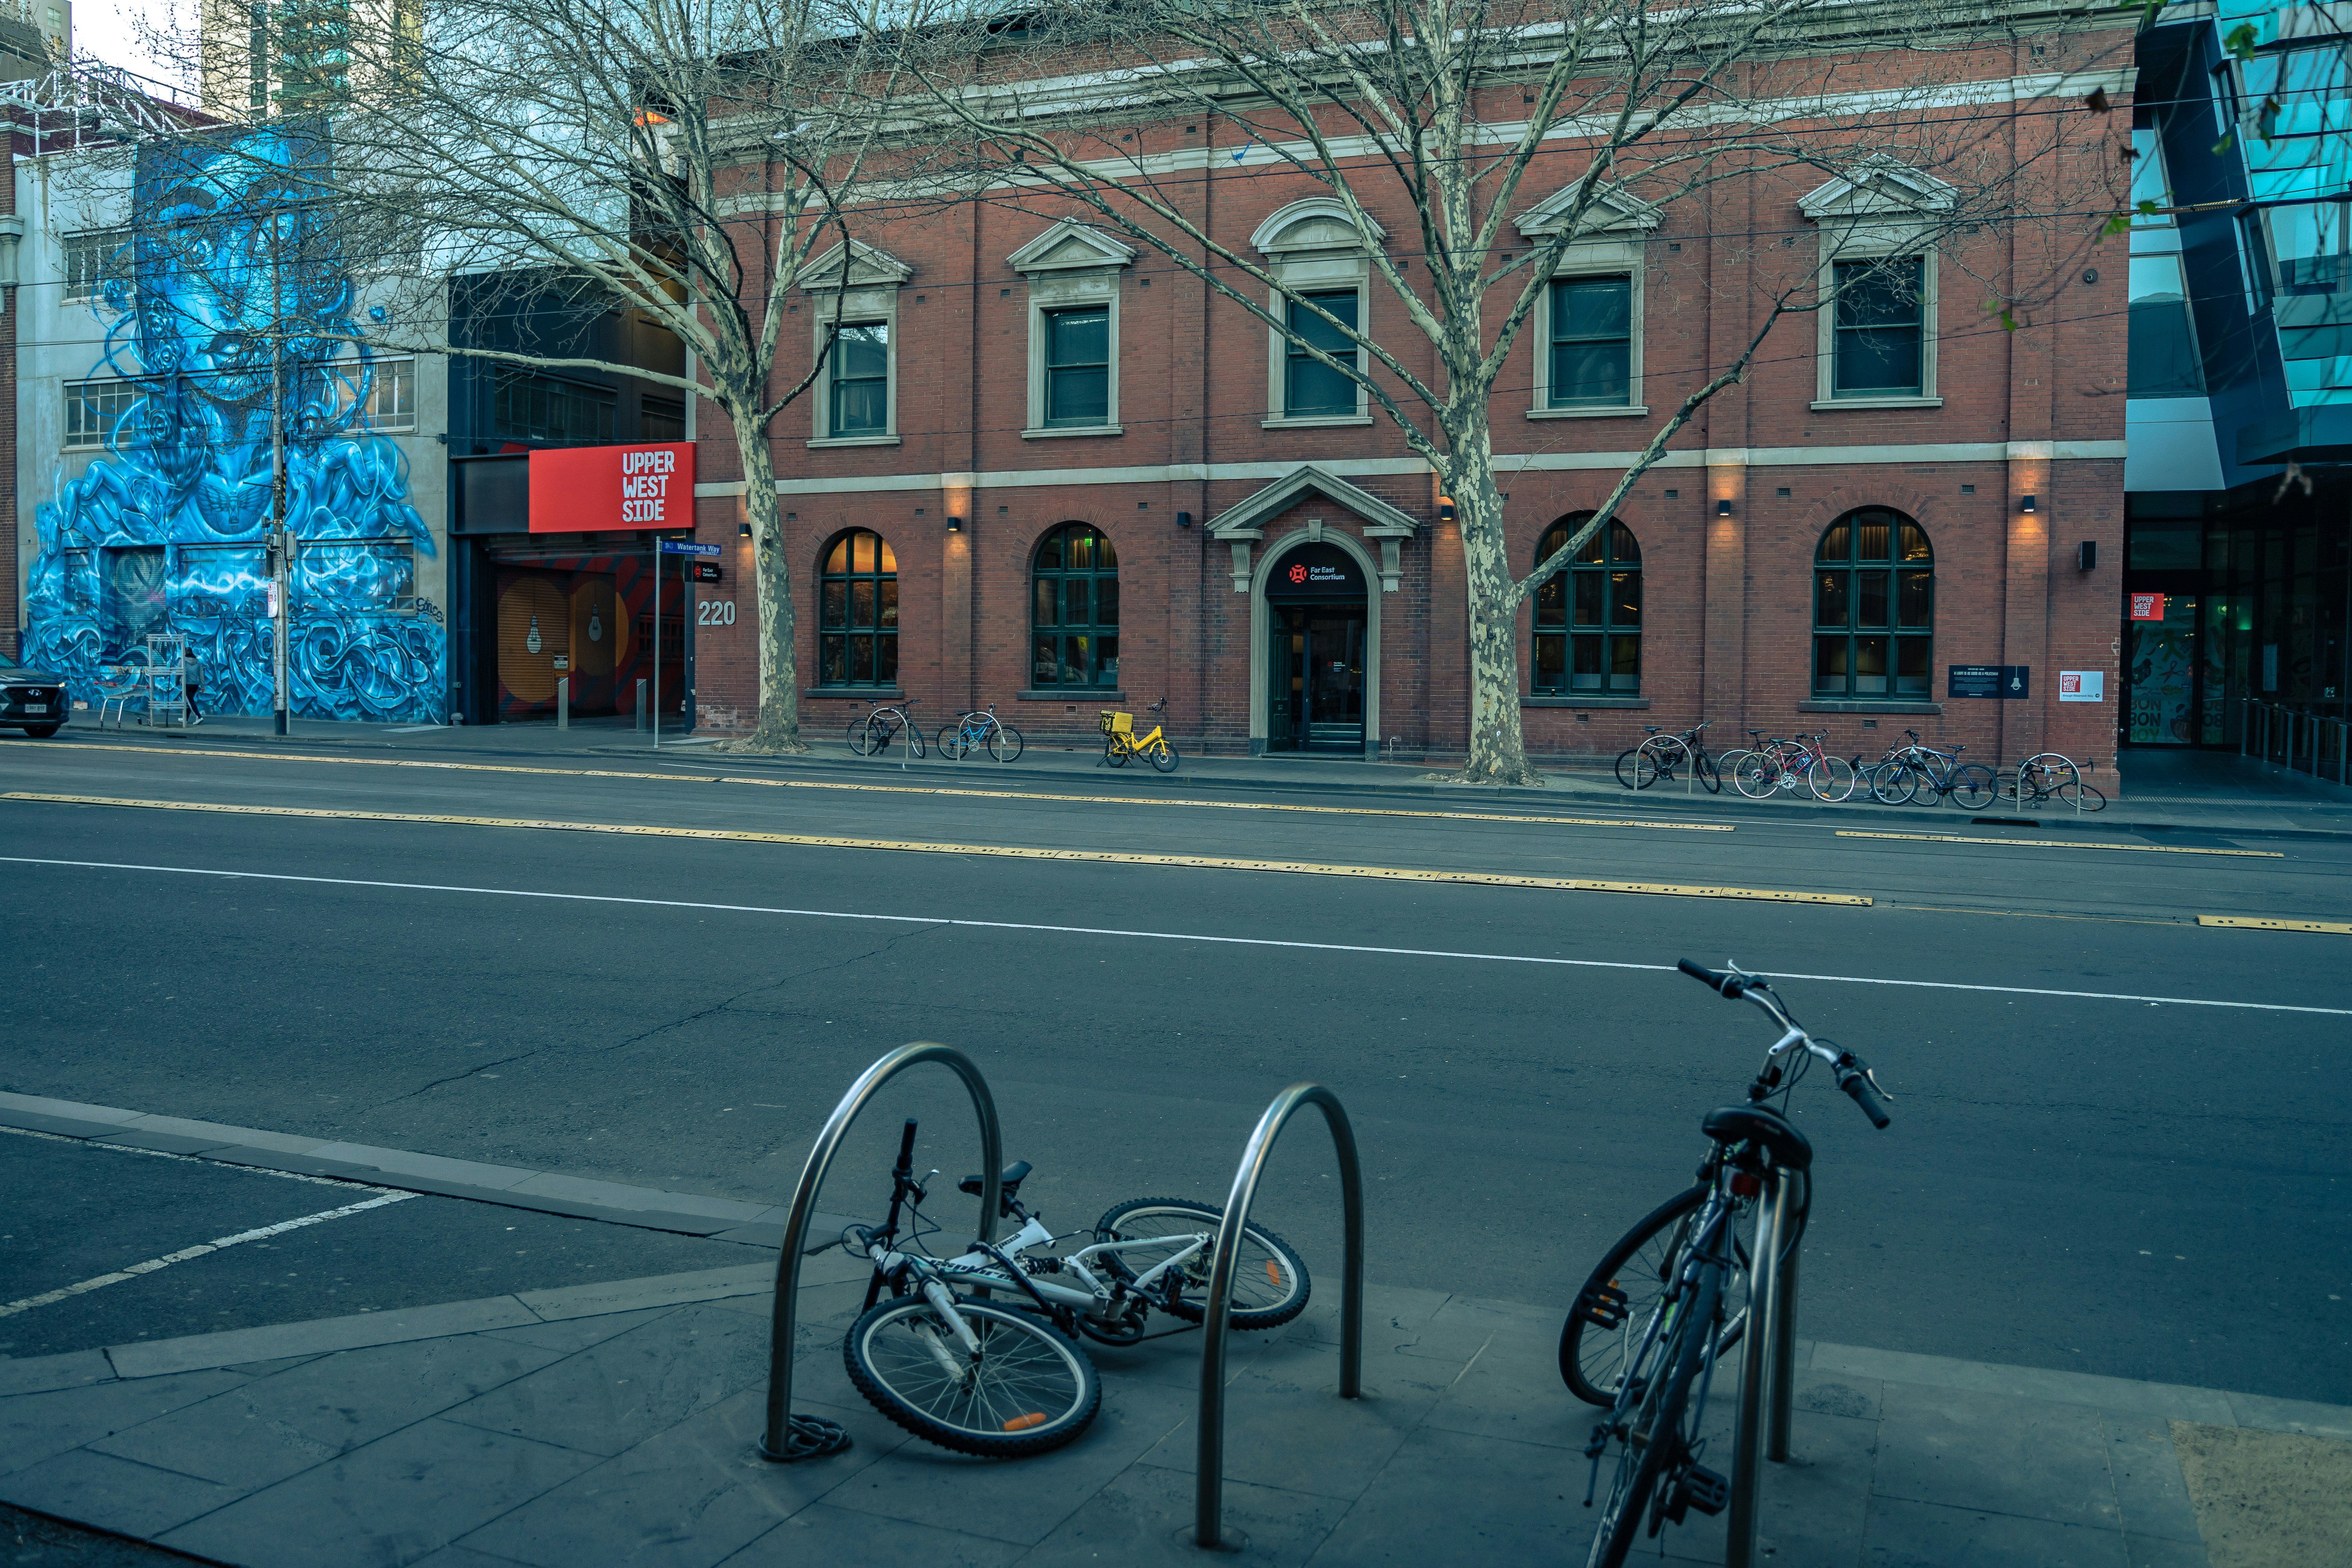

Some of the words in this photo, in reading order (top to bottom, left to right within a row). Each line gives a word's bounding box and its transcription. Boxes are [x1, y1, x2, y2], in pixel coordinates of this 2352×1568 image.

[622, 450, 675, 475] UPPER
[622, 475, 669, 498] WEST
[622, 499, 665, 522] SIDE
[677, 543, 706, 552] Watertank
[708, 545, 720, 554] Way
[699, 601, 735, 625] 220
